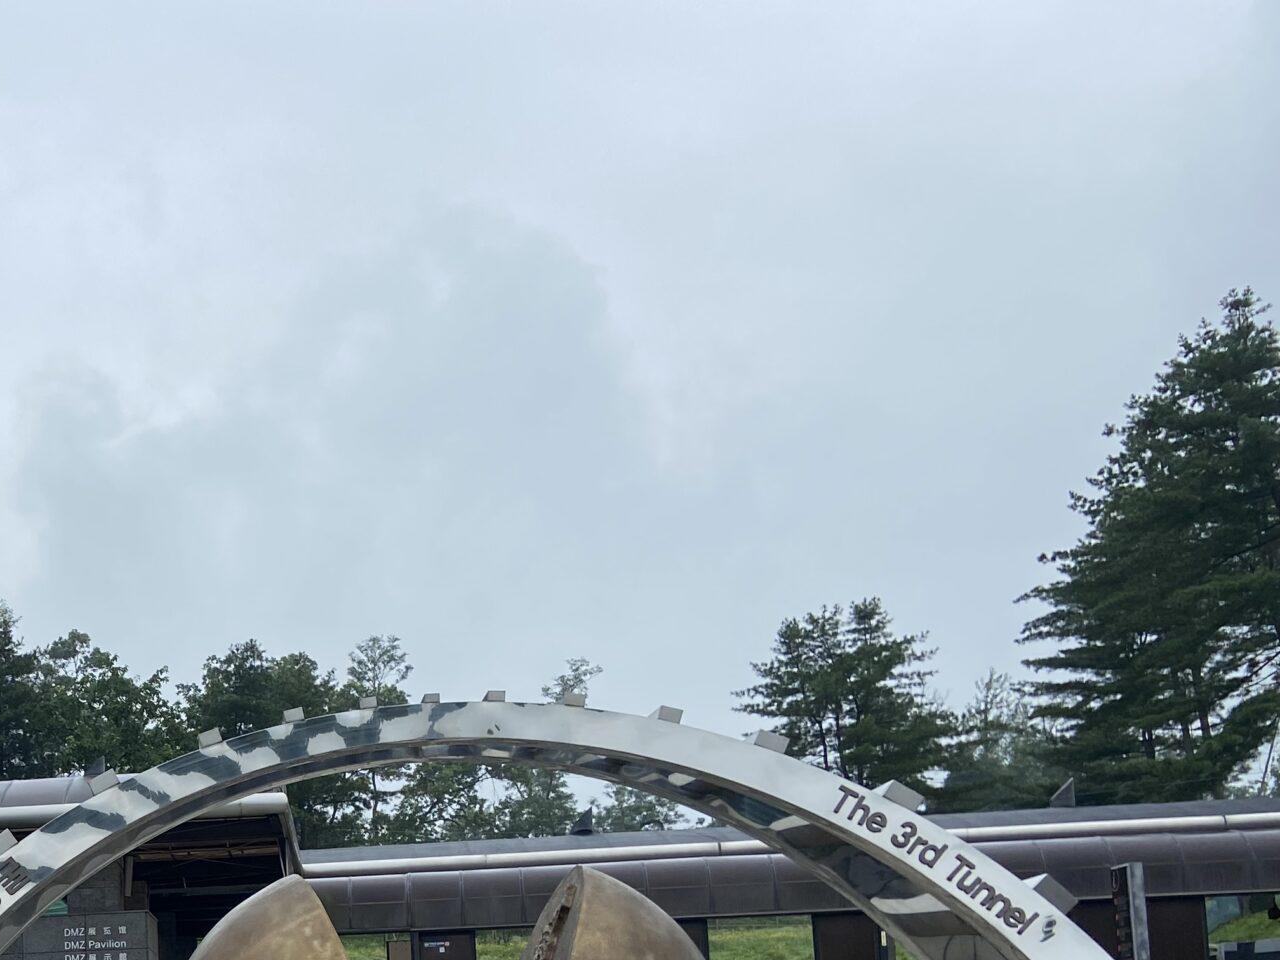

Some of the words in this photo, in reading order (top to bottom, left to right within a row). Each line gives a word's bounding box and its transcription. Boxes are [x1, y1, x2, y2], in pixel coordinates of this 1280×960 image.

[833, 785, 888, 833] The
[890, 821, 949, 869] 3rd
[946, 854, 1040, 936] Tunnel
[64, 927, 85, 937] DMZ
[64, 940, 86, 950] DMZ
[88, 940, 127, 949] Pavilion
